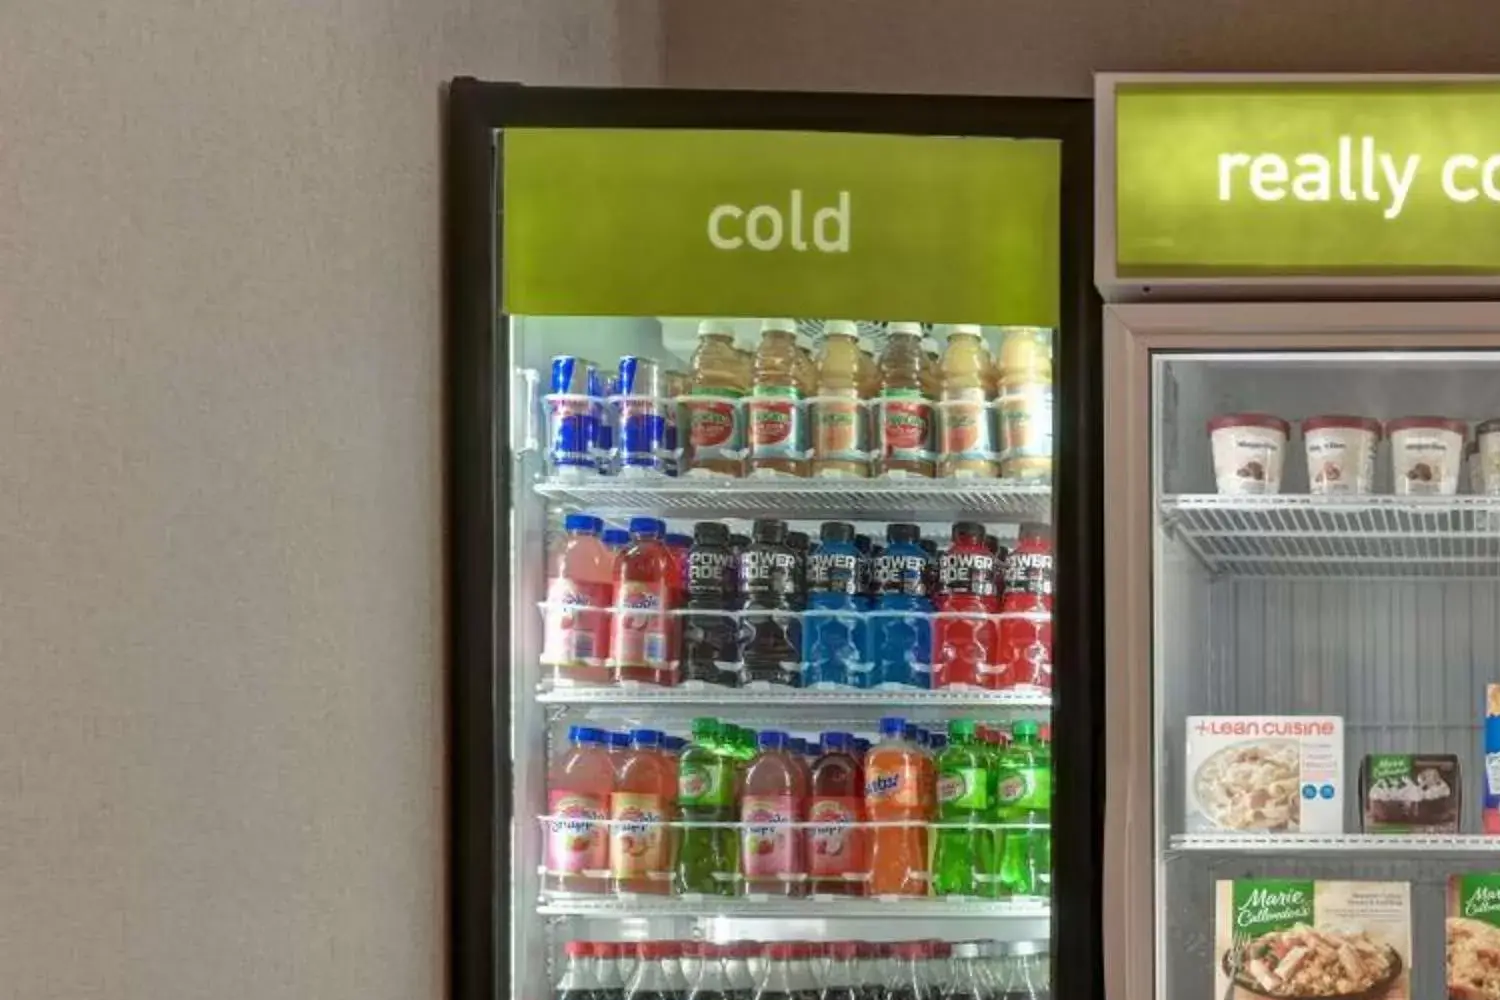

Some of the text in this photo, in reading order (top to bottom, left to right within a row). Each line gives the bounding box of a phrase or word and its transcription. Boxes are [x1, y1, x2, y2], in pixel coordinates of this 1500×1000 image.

[1217, 135, 1421, 218] really
[707, 189, 850, 253] cold
[1239, 889, 1304, 910] Marie
